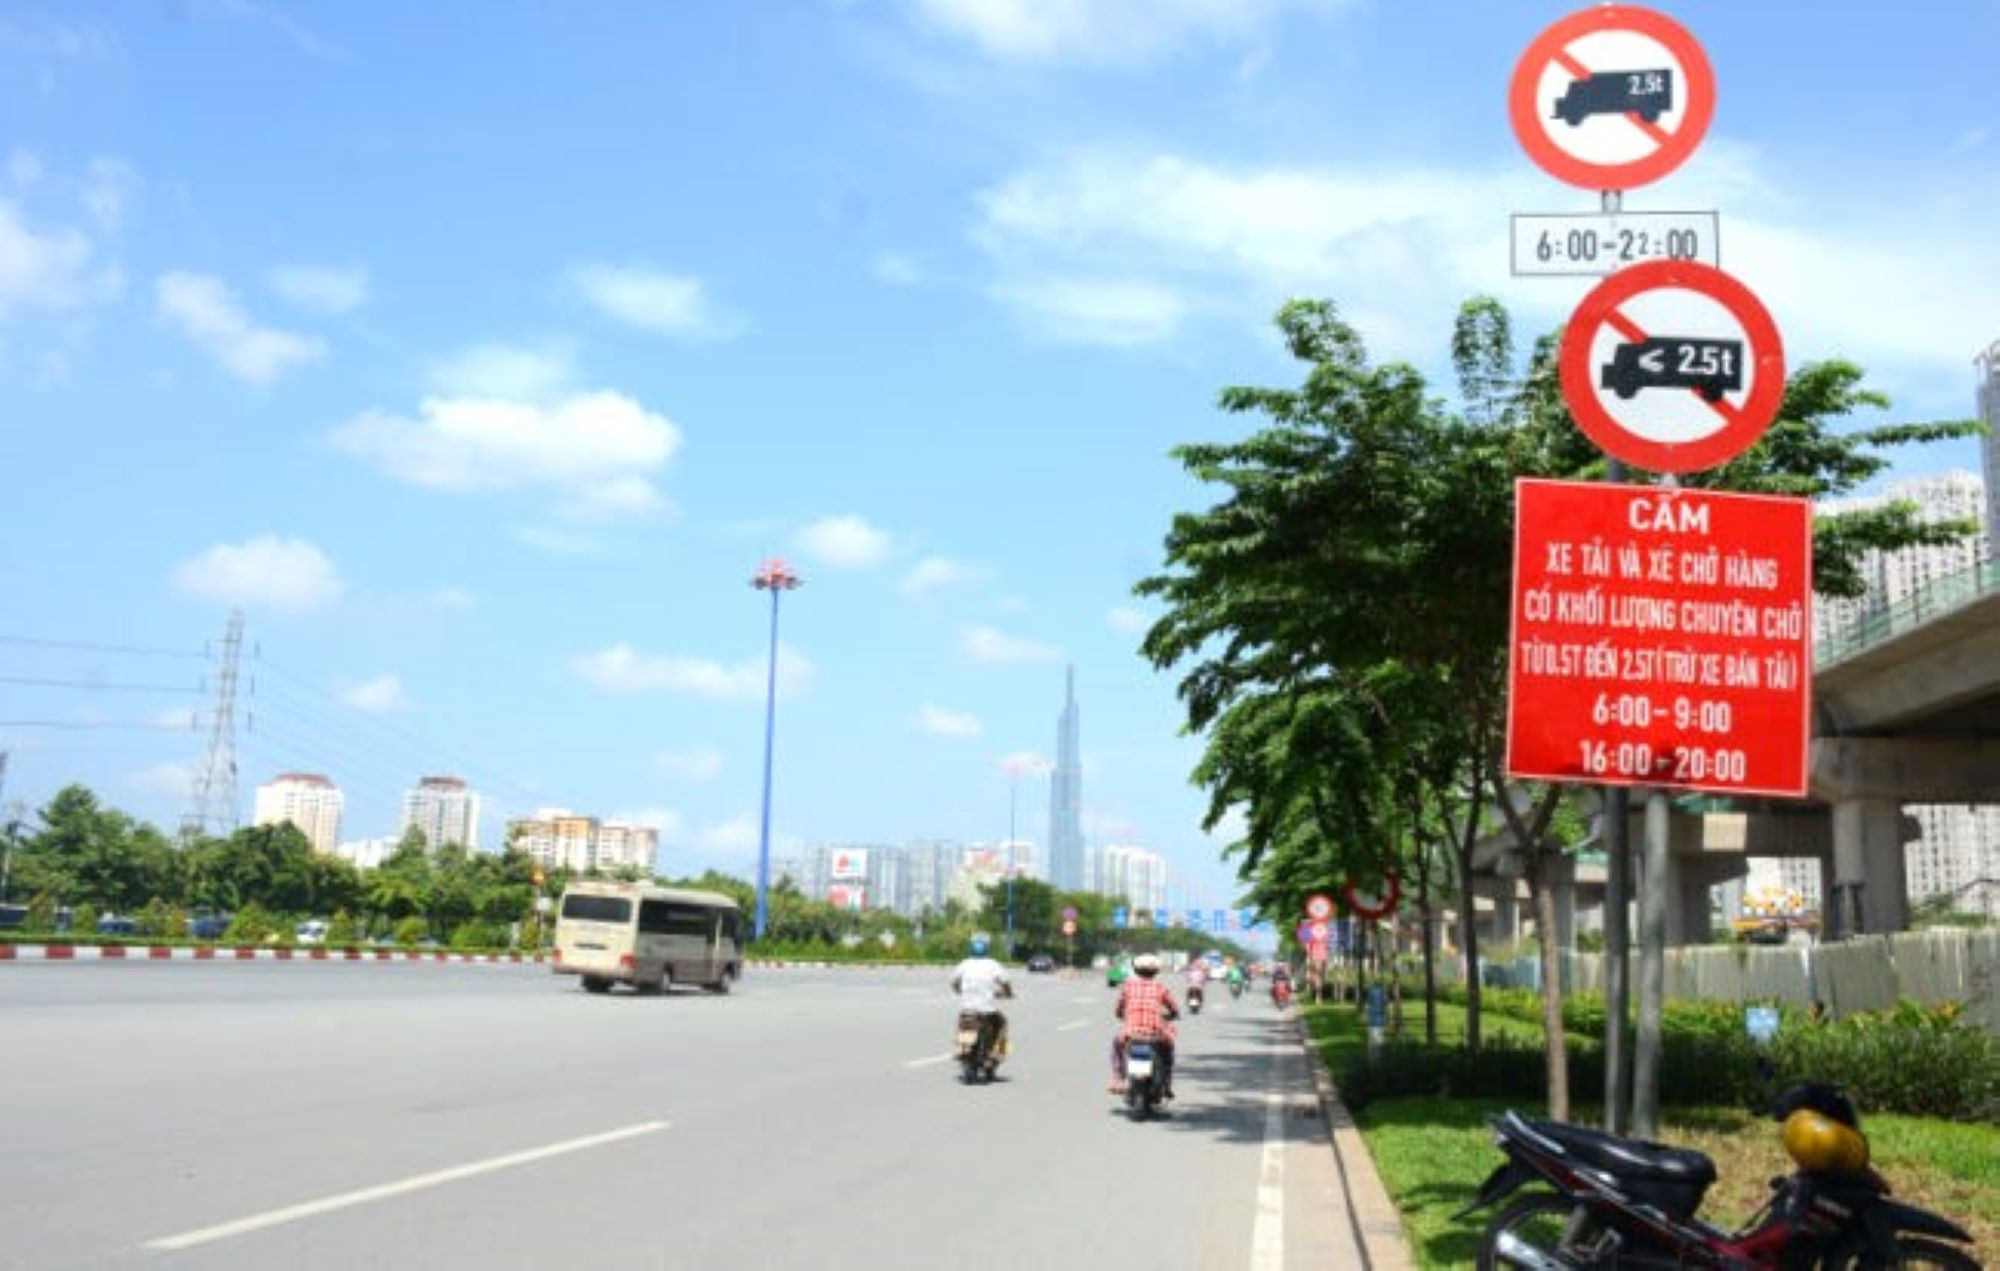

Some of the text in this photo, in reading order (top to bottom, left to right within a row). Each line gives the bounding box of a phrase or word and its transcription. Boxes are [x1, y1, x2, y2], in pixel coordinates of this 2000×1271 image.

[1629, 73, 1664, 95] 2.5t
[1629, 489, 1710, 535] CẤM
[1546, 542, 1573, 575] XE
[1580, 536, 1612, 577] TẢI
[1617, 540, 1641, 578] VÀ
[1681, 546, 1720, 585] CHỞ
[1725, 549, 1778, 590] HÀNG
[1524, 582, 1551, 622] CÓ
[1557, 583, 1606, 626] KHỐI
[1611, 594, 1677, 636] LƯỢNG
[1700, 653, 1721, 686] XE
[1725, 648, 1759, 688] BÁN
